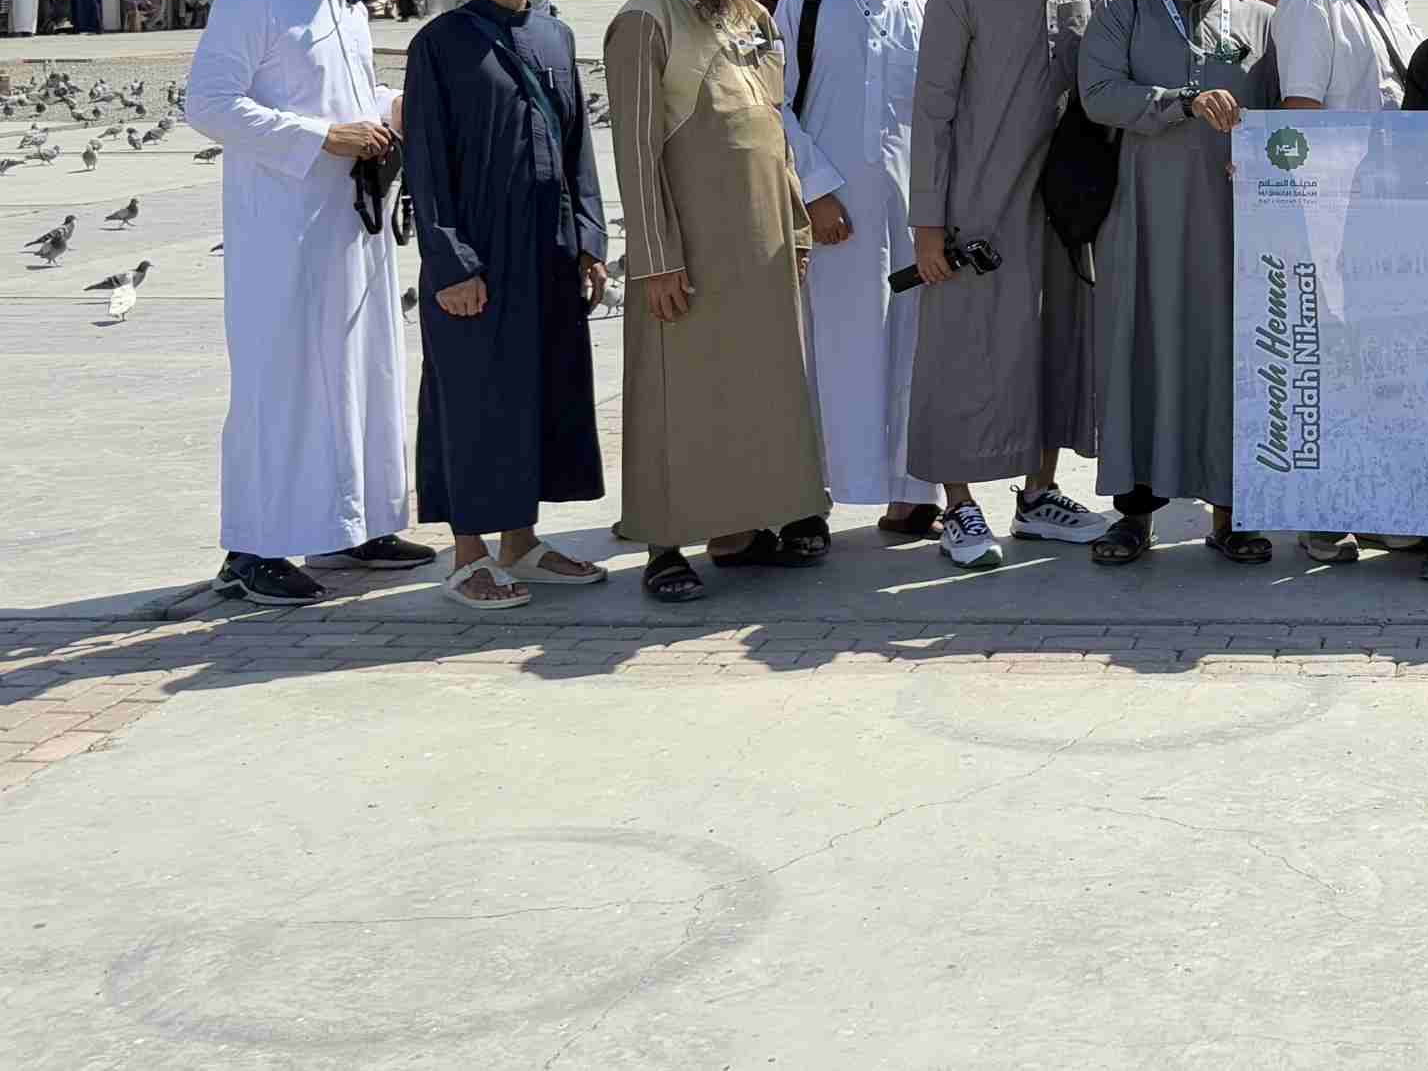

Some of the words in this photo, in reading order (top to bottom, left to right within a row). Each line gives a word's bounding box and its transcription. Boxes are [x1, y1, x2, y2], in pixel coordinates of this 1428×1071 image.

[1255, 254, 1291, 359] Hemat
[1293, 262, 1320, 364] Nikmat
[1256, 363, 1291, 472] Umroh
[1293, 369, 1320, 469] Ibadah
